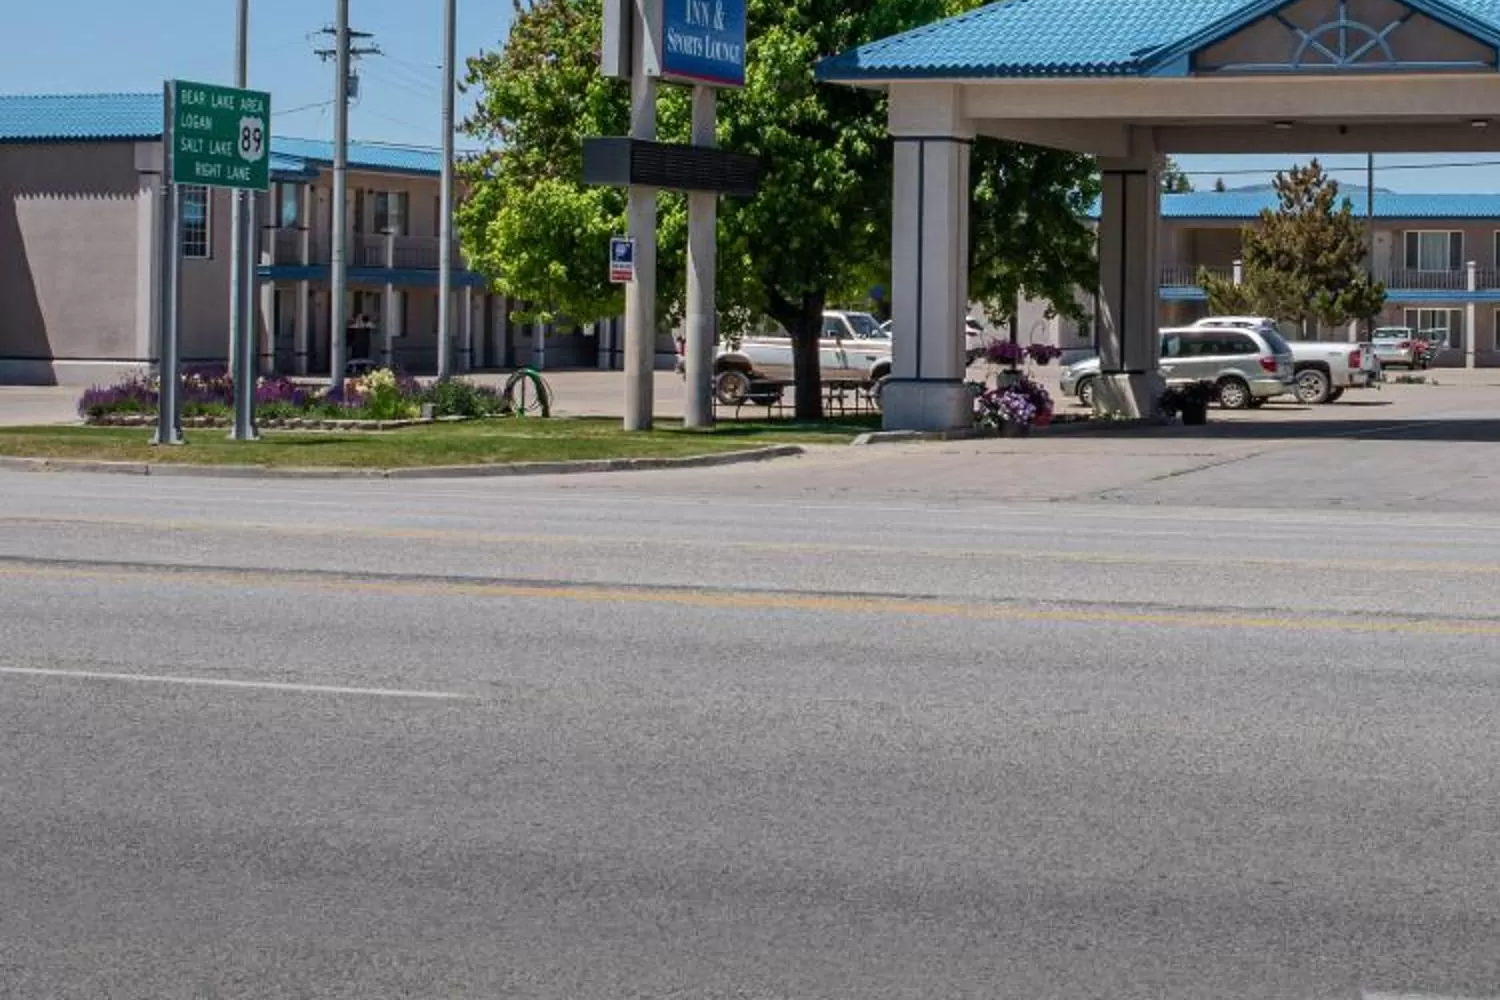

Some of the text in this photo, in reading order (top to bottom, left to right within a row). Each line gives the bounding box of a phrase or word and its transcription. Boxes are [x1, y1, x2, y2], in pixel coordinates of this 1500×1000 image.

[713, 0, 726, 31] &
[667, 26, 740, 65] SPORTS LOUNGE
[181, 88, 264, 113] BEAR LAKE AREA
[180, 113, 212, 130] LOGAN
[180, 136, 233, 157] SALT LAKE
[241, 126, 262, 152] 89
[195, 161, 251, 181] RIGHT LANE
